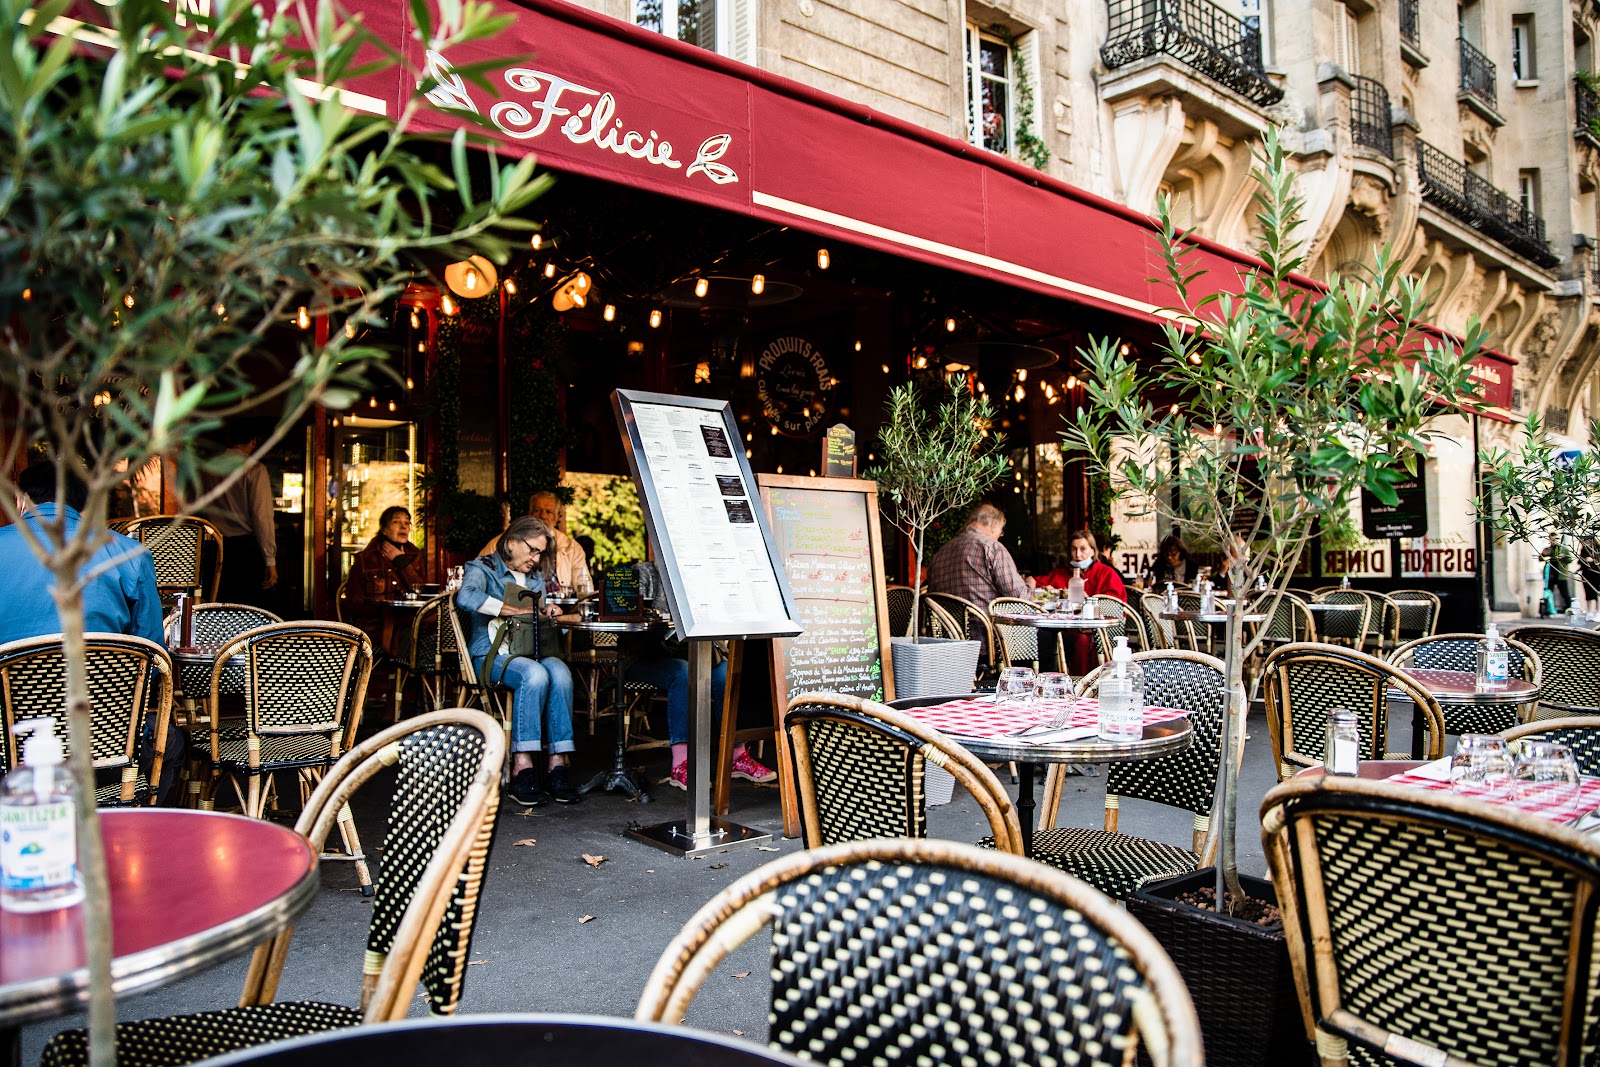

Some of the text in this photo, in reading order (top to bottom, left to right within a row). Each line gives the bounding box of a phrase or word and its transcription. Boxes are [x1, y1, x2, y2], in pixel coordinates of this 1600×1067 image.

[490, 68, 682, 168] Félicie
[758, 336, 832, 391] PRODUITS FRAIS
[783, 420, 801, 431] sur
[804, 405, 825, 433] place
